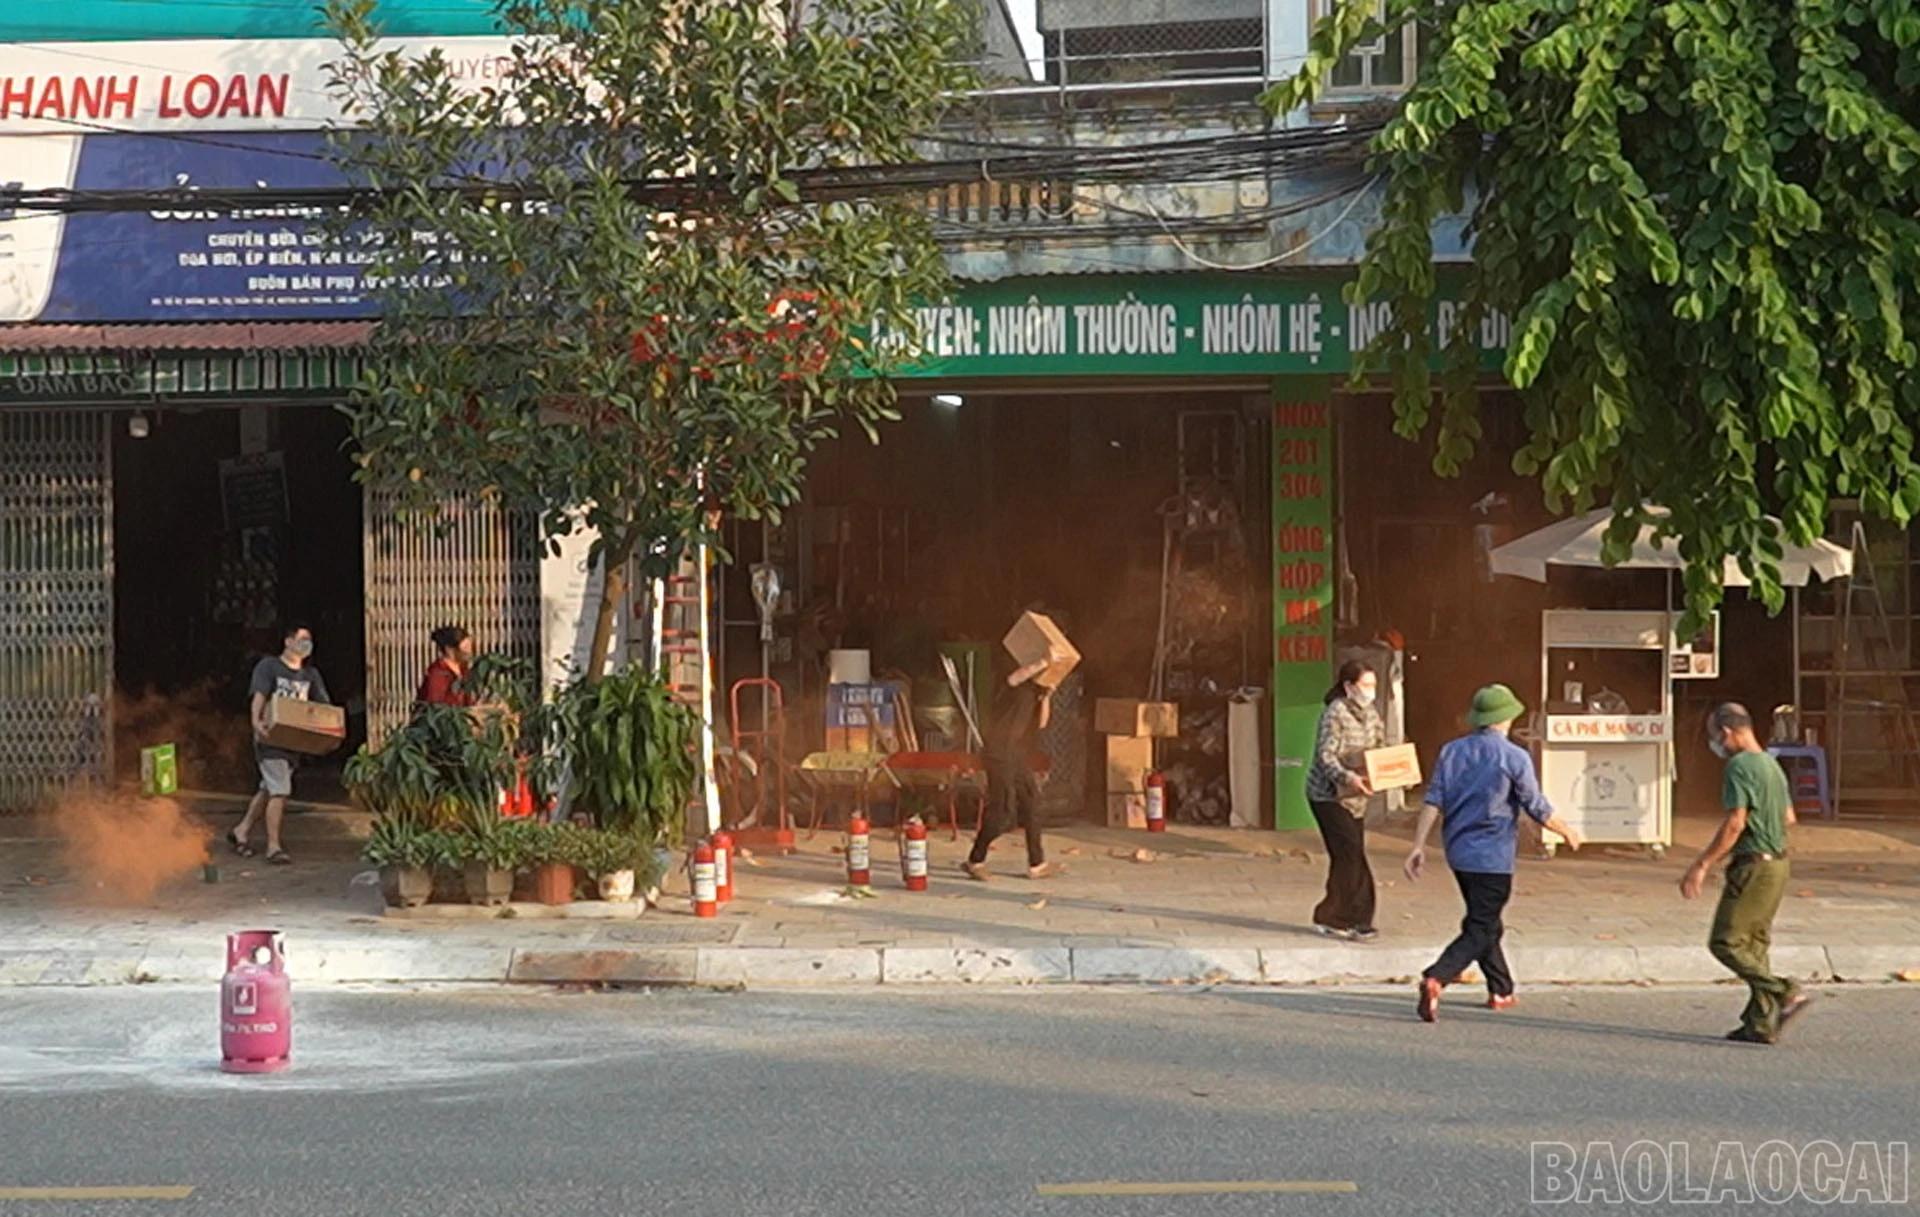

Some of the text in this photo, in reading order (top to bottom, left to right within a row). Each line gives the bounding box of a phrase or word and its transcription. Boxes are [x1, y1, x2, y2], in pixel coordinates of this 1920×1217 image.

[0, 73, 290, 120] HANH LOAN
[988, 295, 1066, 355] NHÔM
[1074, 292, 1177, 355] THƯỜNG
[1202, 293, 1281, 354] NHÔM
[1289, 293, 1323, 364] HỆ
[1350, 302, 1412, 352] INO
[1275, 403, 1327, 429] INOX
[1279, 439, 1319, 466] 201
[1280, 473, 1323, 498] 304
[1605, 721, 1646, 736] MANG
